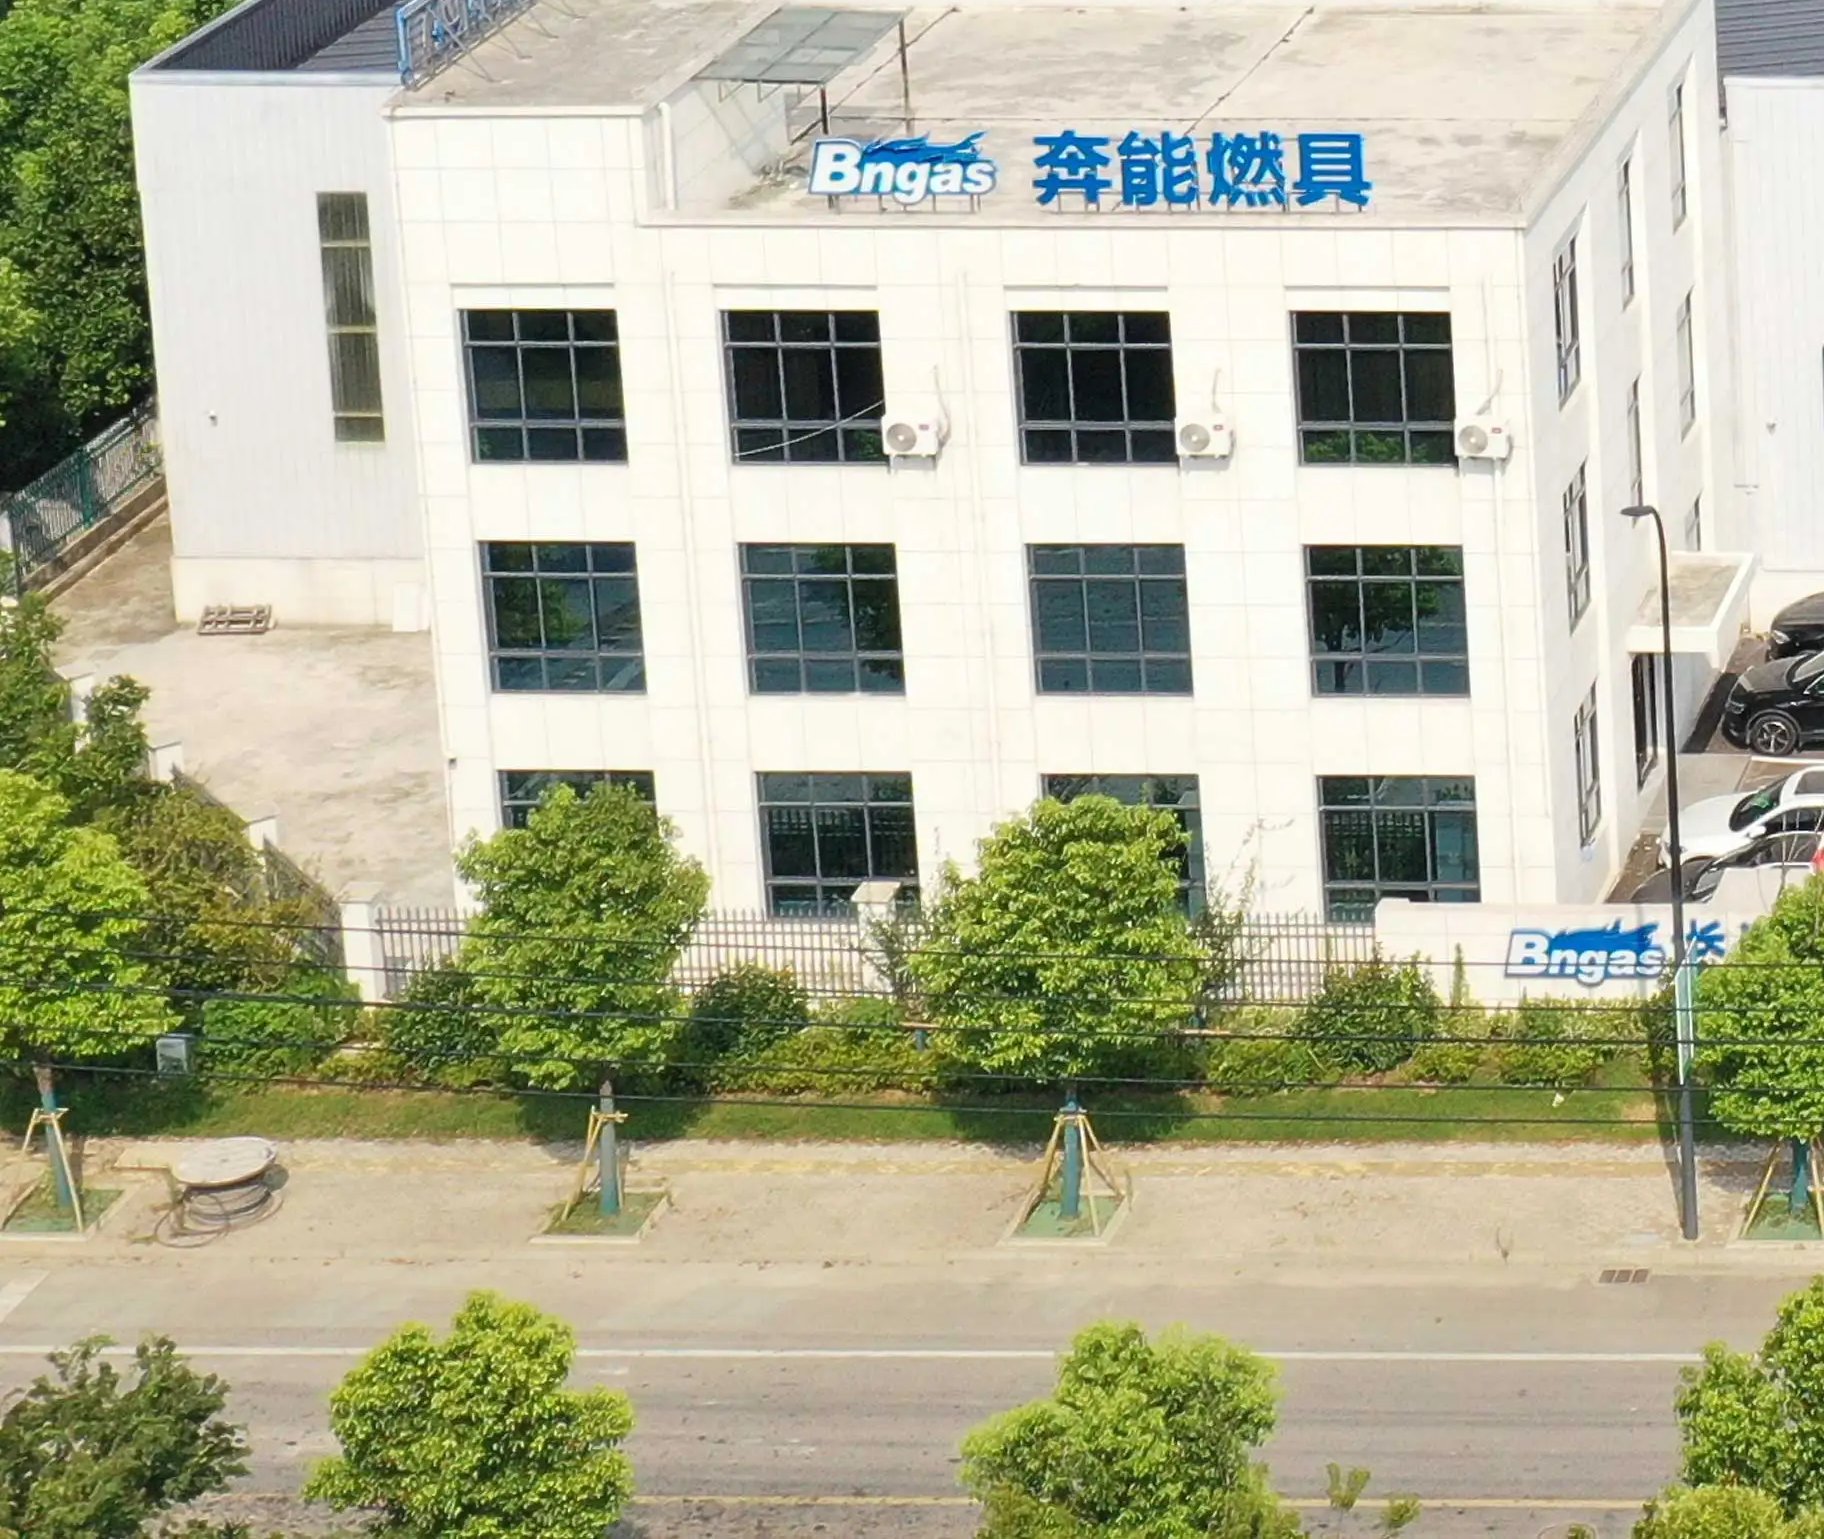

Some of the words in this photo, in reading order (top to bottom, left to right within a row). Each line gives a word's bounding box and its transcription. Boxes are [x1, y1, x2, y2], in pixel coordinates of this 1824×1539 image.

[808, 138, 997, 205] Bngas
[1032, 129, 1373, 207] 奔能燃具
[1504, 930, 1668, 986] Bngas
